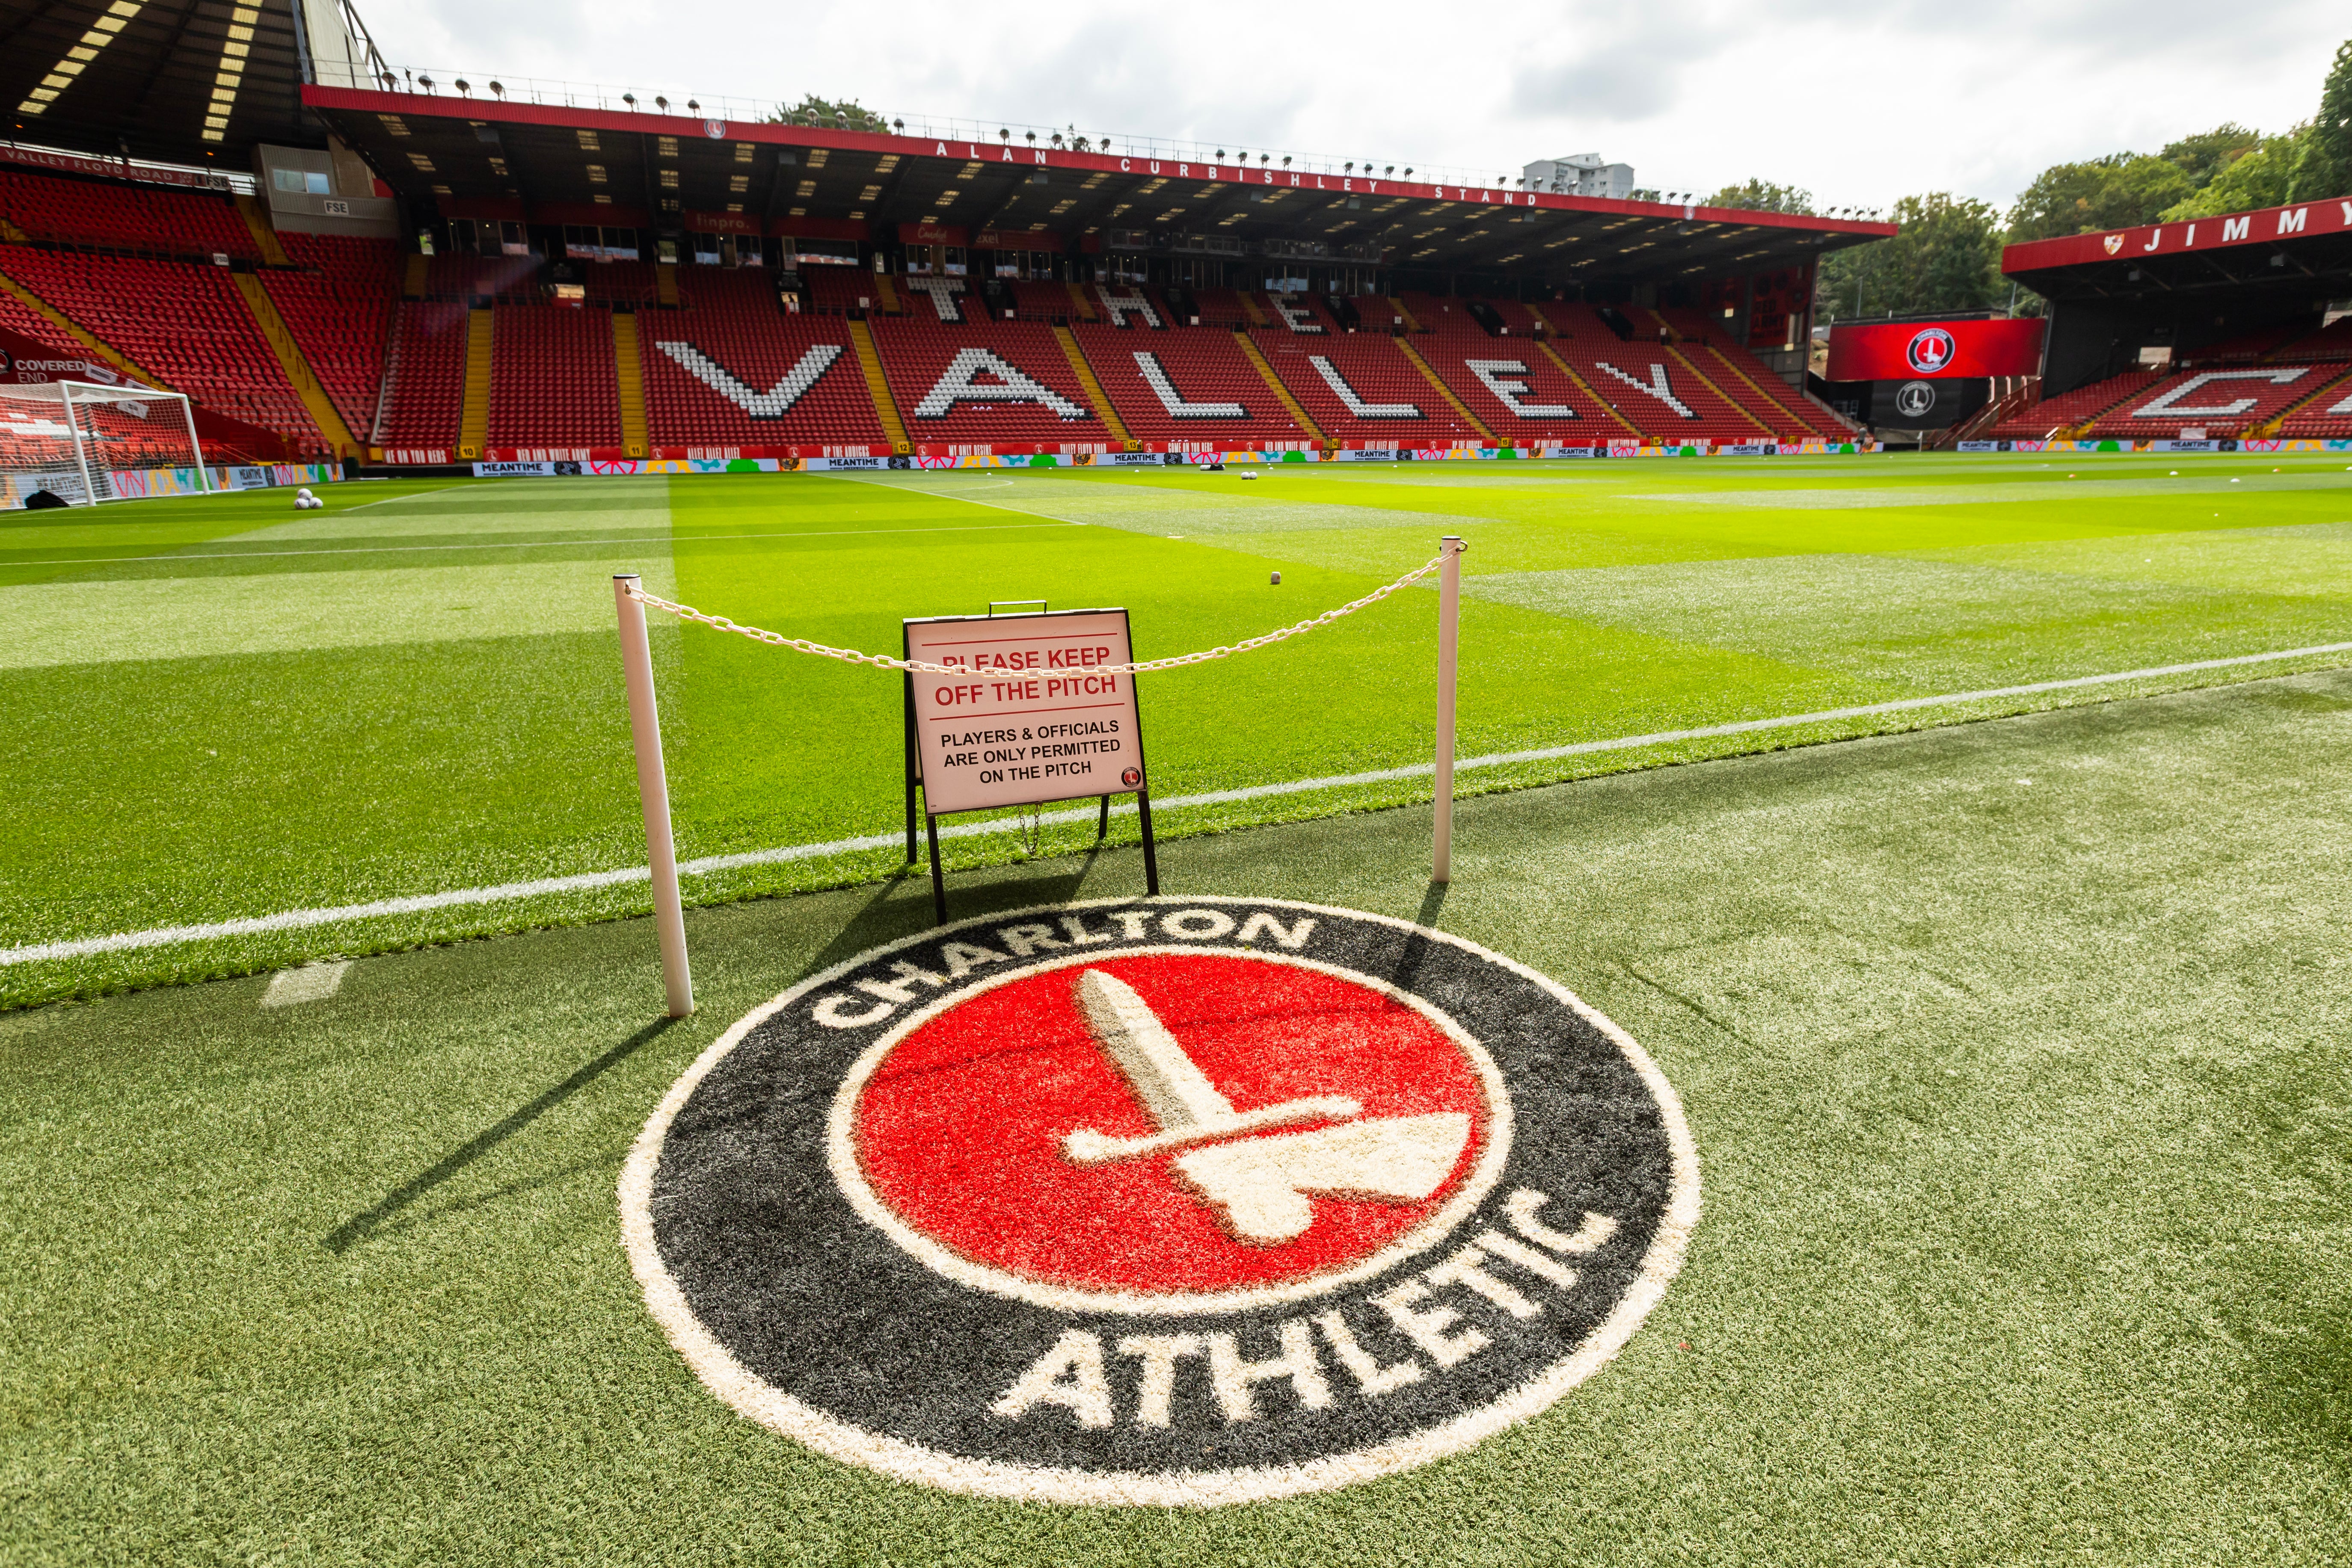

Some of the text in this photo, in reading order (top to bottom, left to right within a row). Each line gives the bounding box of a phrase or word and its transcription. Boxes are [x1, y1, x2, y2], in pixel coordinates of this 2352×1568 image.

[6, 149, 66, 167] VALLEY
[74, 160, 123, 174] FLOYD
[130, 169, 172, 182] ROAD
[936, 141, 1536, 205] ALAN CURBISHLEY STAND
[206, 175, 228, 188] FSB
[326, 202, 347, 213] FSE
[906, 276, 1323, 333] THE
[15, 360, 86, 371] COVERED
[18, 372, 48, 383] END
[655, 341, 1693, 419] VALLEY
[632, 446, 640, 454] 11
[823, 445, 869, 457] UP THE ADDICKS
[949, 444, 992, 456] MY ONLY DESIRE
[1060, 443, 1107, 454] VALLEY FLOYD ROAD
[1168, 442, 1213, 453] COME ON YOU REDS
[1265, 441, 1311, 451] RED AND WHITE ARMY
[1364, 441, 1399, 450] ALLEZ ALLEZ ALLEZ
[1452, 440, 1457, 449] UP
[397, 449, 409, 463] ON
[410, 449, 426, 463] YOU
[427, 449, 447, 463] REDS
[463, 448, 473, 456] 10
[516, 448, 590, 462] RED AND WHITE ARMY
[687, 447, 741, 460] ALLEZ ALLEZ ALLEZ
[482, 463, 543, 472] MEANTIME
[829, 458, 879, 466] MEANTIME
[942, 646, 1110, 675] PLEASE KEEP
[935, 675, 1117, 706] OFF THE PITCH
[941, 720, 1120, 748] PLAYERS & OFFICIALS
[943, 739, 1121, 768] ARE ONLY PERMITTED
[979, 761, 1092, 784] ON THE PITCH
[812, 908, 1318, 1029] CHARLTON
[988, 1187, 1619, 1428] ATHLETIC
